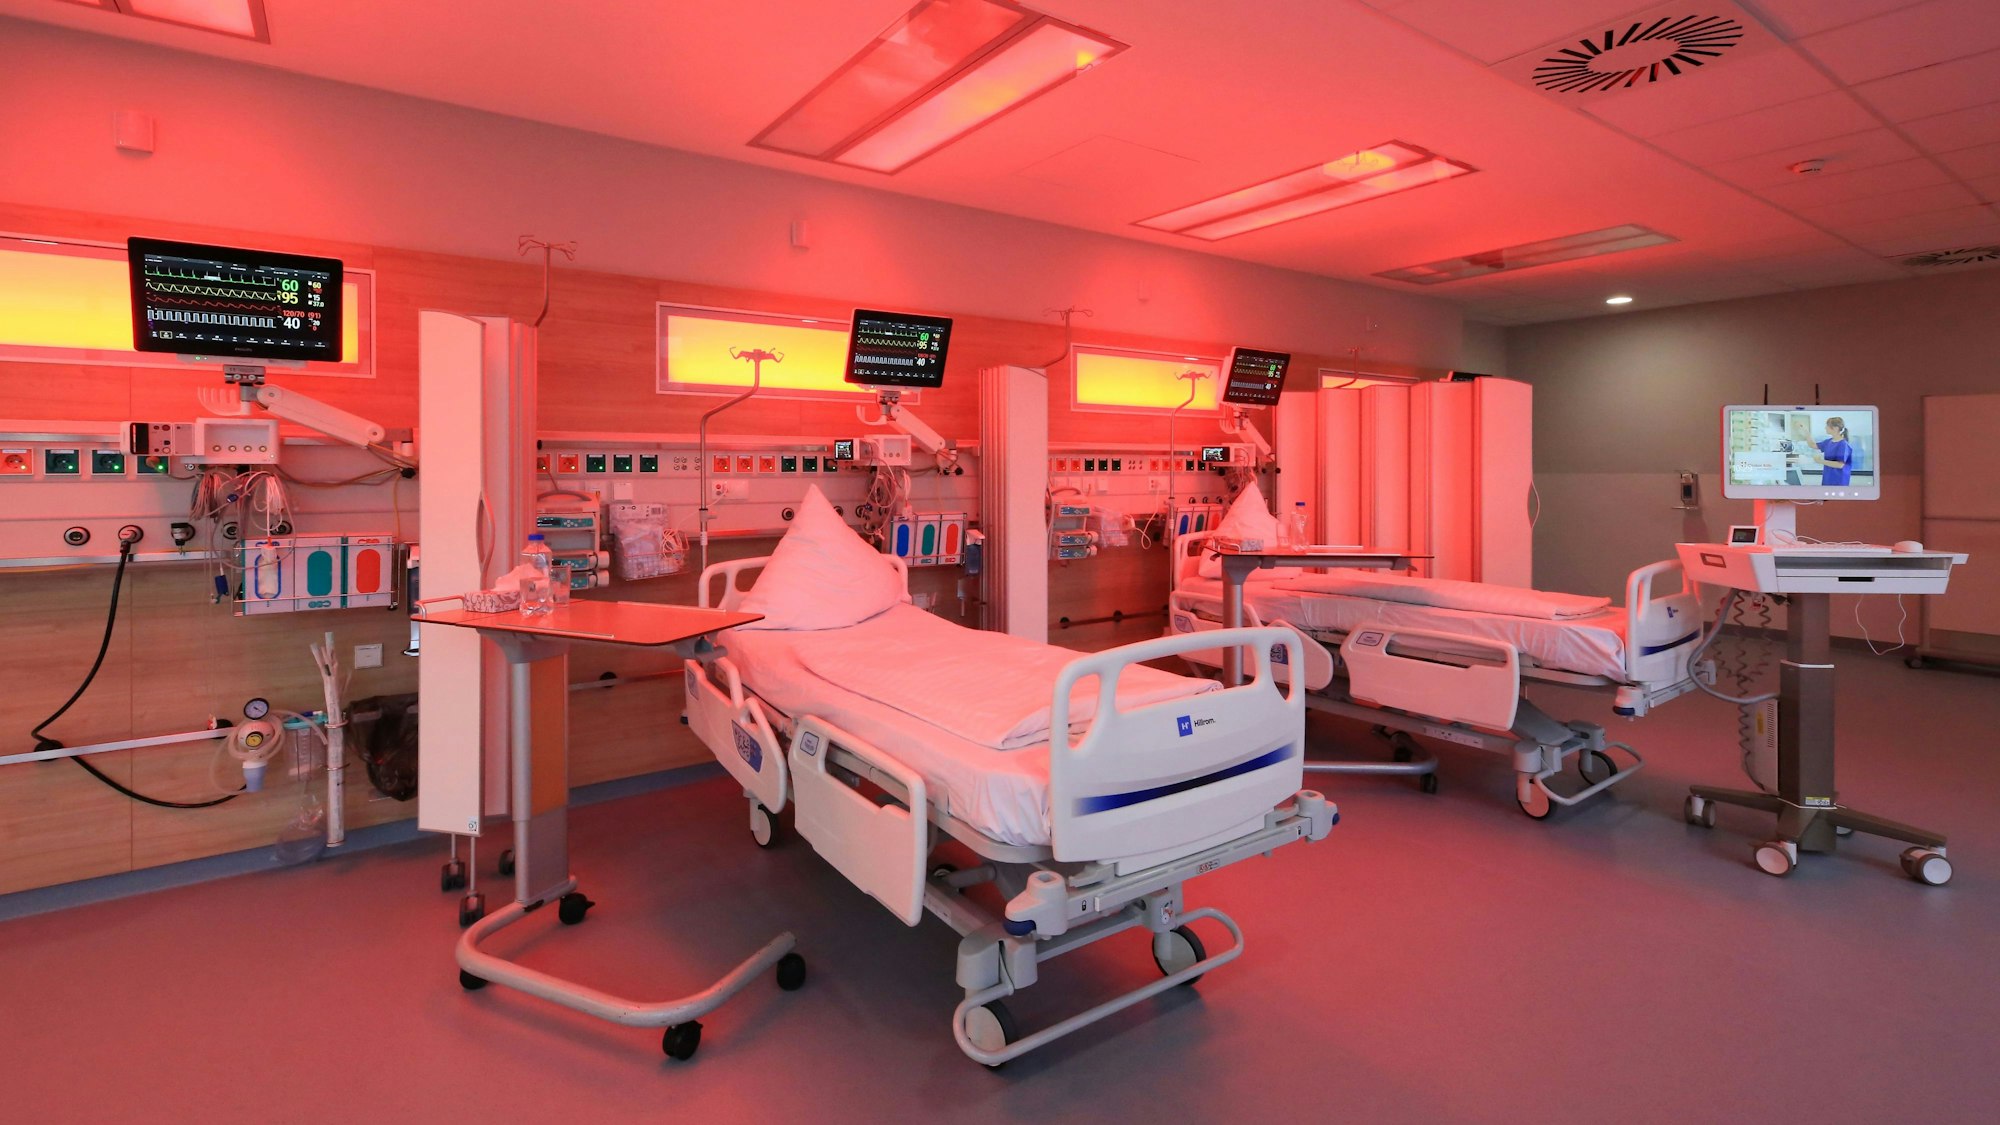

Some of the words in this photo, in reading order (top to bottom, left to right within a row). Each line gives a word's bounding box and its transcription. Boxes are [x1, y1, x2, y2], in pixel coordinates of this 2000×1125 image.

[282, 279, 299, 291] 60
[281, 291, 299, 305] 95
[282, 310, 305, 318] 120/70
[284, 317, 300, 329] 40
[920, 333, 929, 341] 60
[919, 342, 928, 350] 95
[916, 358, 926, 366] 40
